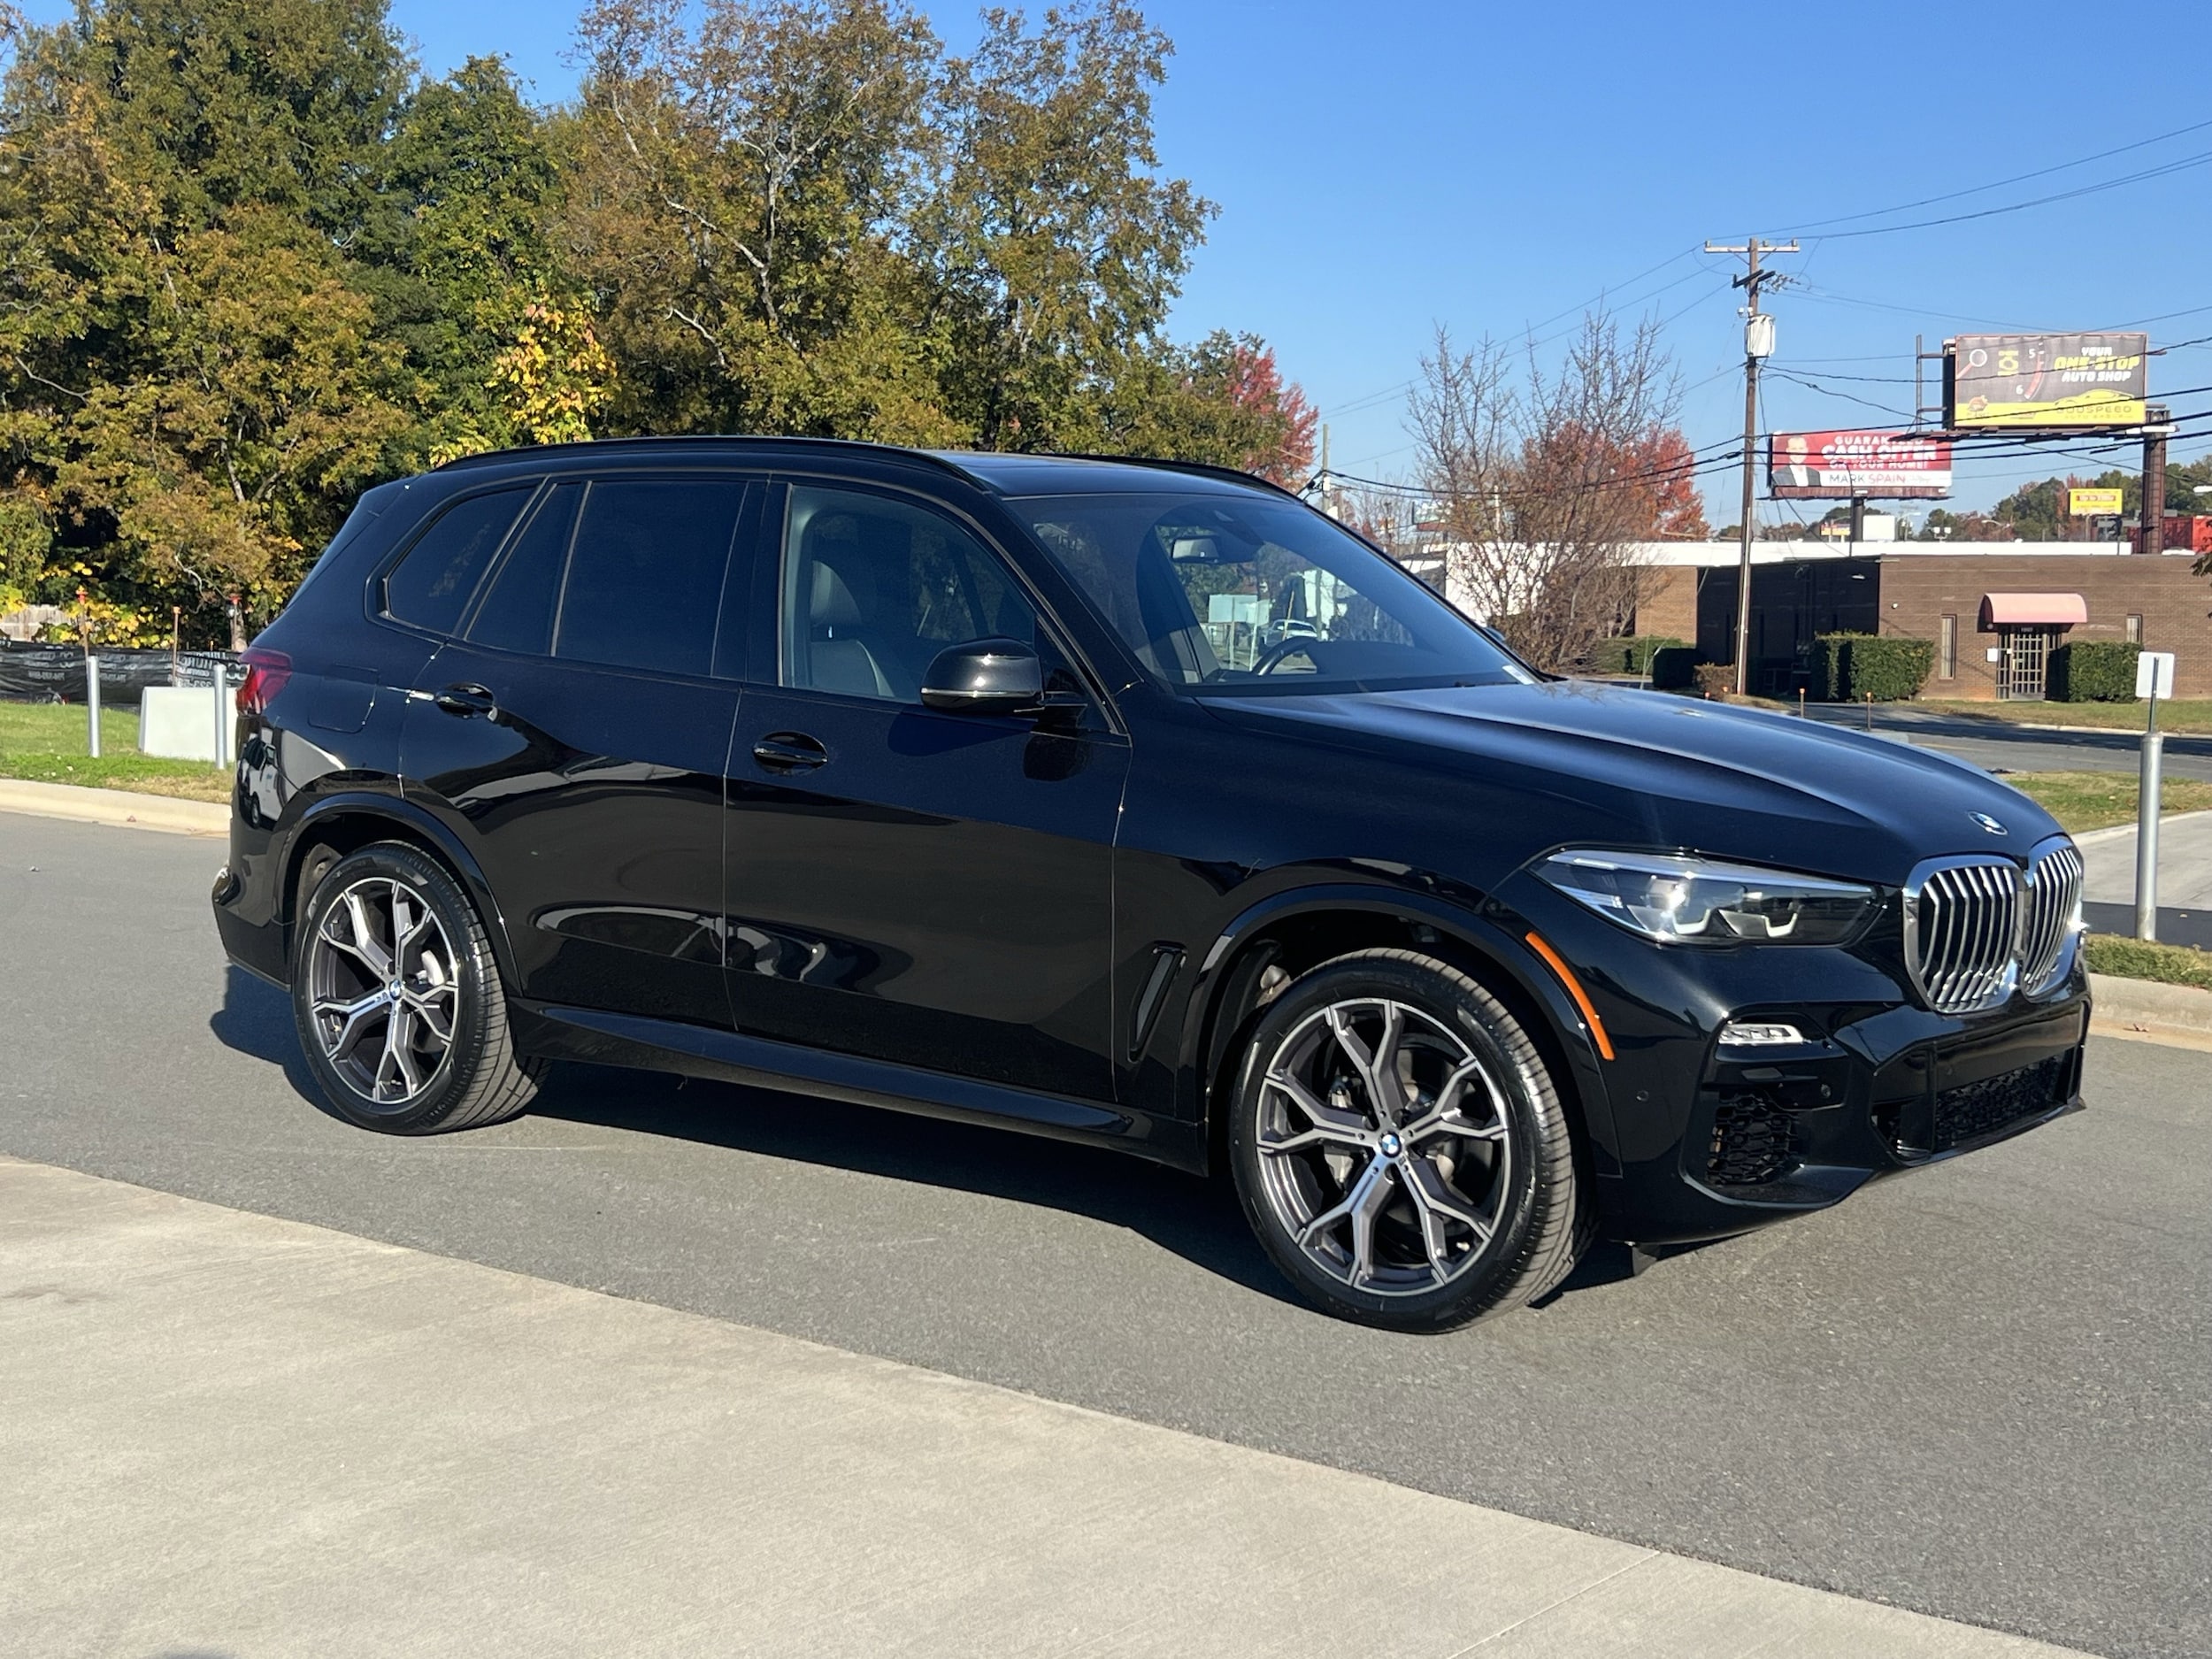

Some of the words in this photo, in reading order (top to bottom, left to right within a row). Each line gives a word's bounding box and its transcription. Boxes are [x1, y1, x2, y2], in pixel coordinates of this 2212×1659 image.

[2029, 349, 2037, 359] 5
[2081, 346, 2113, 357] YOUR
[2055, 357, 2140, 371] ONE-STOP
[2061, 371, 2097, 382] AUTO
[2097, 371, 2131, 382] SHOP
[2016, 385, 2024, 395] 6
[1834, 434, 1924, 445] GUARAN
[1821, 445, 1873, 460] CASH
[1877, 445, 1937, 460] OFFER
[1853, 459, 1885, 469] YOUR
[1829, 473, 1865, 484] MARK
[1868, 473, 1906, 484] SPAIN
